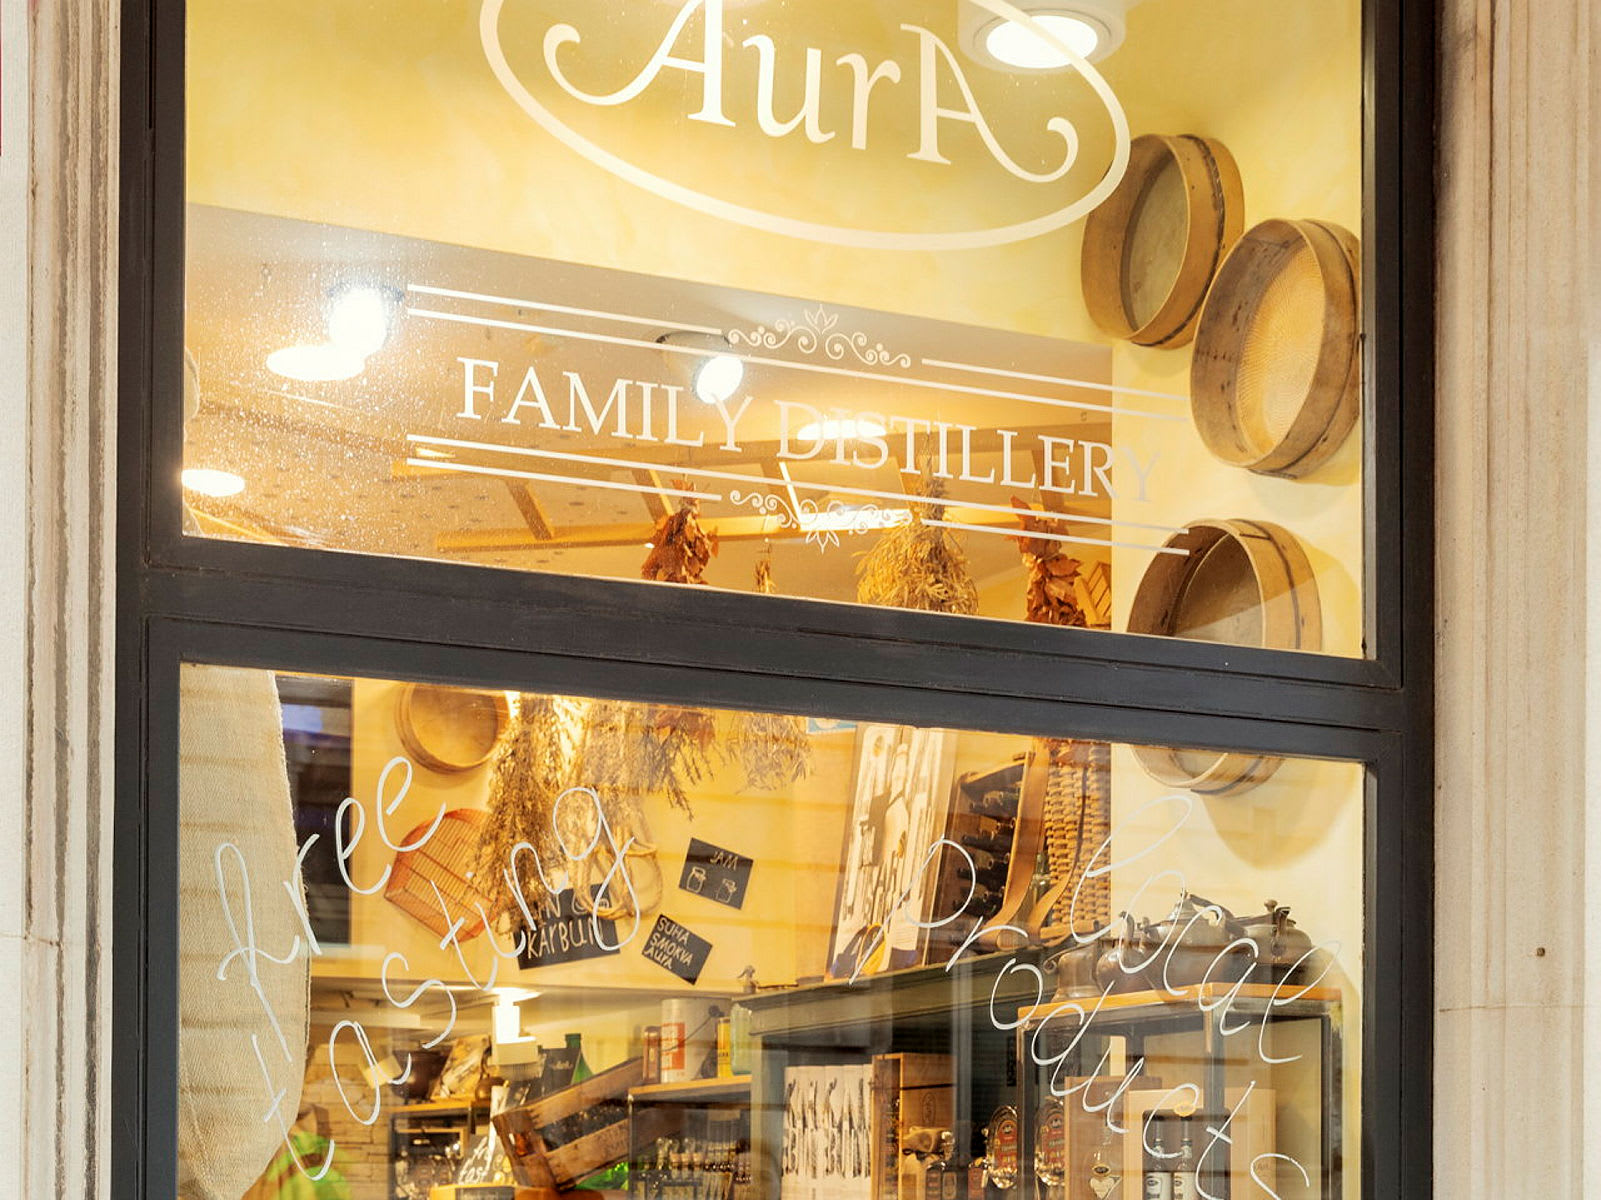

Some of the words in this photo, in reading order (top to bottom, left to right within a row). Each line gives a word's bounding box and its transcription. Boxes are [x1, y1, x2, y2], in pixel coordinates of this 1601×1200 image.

[456, 356, 754, 453] FAMILY
[774, 399, 1163, 502] DISTILLERY
[215, 756, 446, 1061] free
[657, 917, 690, 945] SUHA
[710, 850, 739, 871] JAM
[1071, 795, 1342, 1063] local
[252, 787, 640, 1180] tasting
[650, 932, 694, 966] SMOKVA
